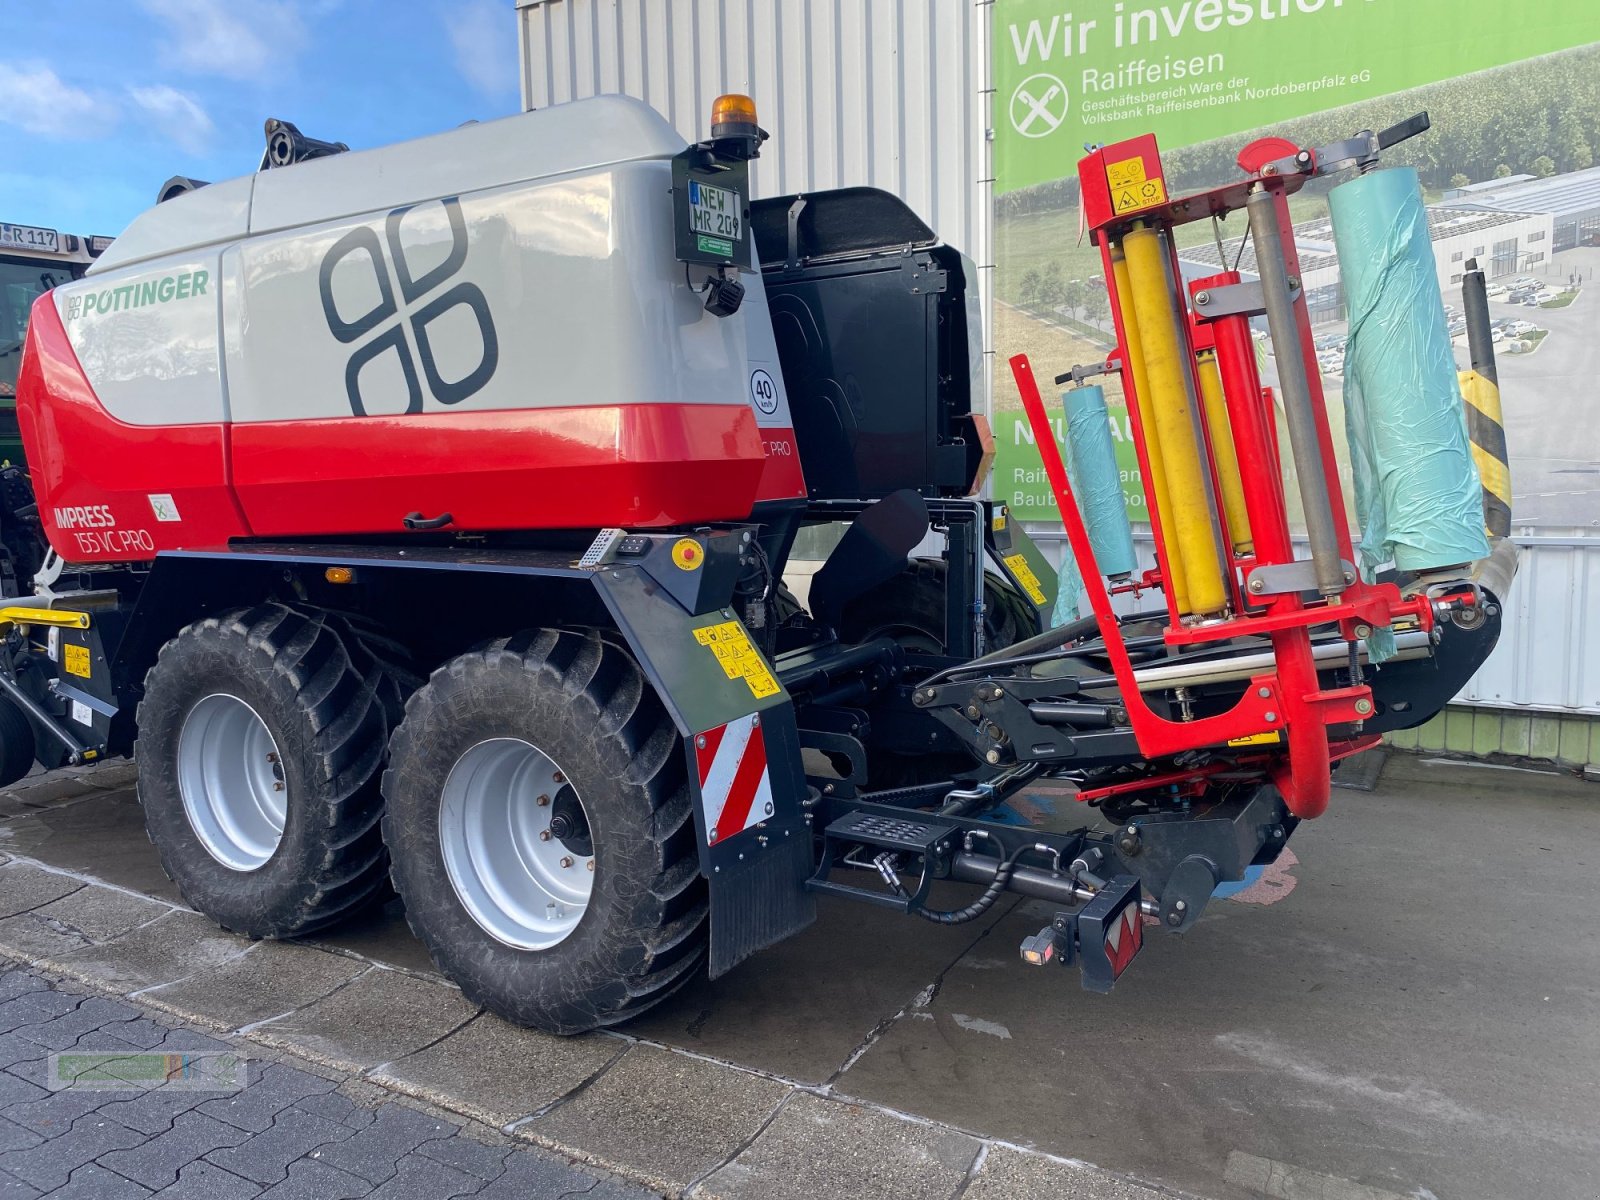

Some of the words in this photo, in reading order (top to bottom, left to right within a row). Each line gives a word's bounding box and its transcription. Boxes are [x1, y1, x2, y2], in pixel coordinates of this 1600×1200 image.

[1009, 13, 1097, 65] Wir
[1082, 53, 1224, 94] Raiffeisen
[1082, 87, 1186, 112] Geschäftsbereich
[1189, 81, 1223, 95] Ware
[1227, 77, 1250, 89] der
[1082, 106, 1143, 125] Volksbank
[1146, 91, 1241, 115] Raiffeisenbank
[1245, 75, 1346, 100] Nordoberpfalz
[1350, 69, 1371, 84] eG
[699, 186, 725, 212] NEW
[1142, 195, 1161, 206] STOP
[693, 208, 712, 231] MR
[717, 213, 739, 236] 209
[13, 228, 24, 243] R
[27, 230, 55, 246] 117
[82, 270, 209, 318] PÖTTINGER
[756, 380, 772, 400] 40
[770, 441, 791, 457] PRO
[54, 505, 116, 529] IMPRESS
[74, 532, 101, 553] 155
[96, 531, 122, 552] VC
[118, 529, 155, 551] PRO
